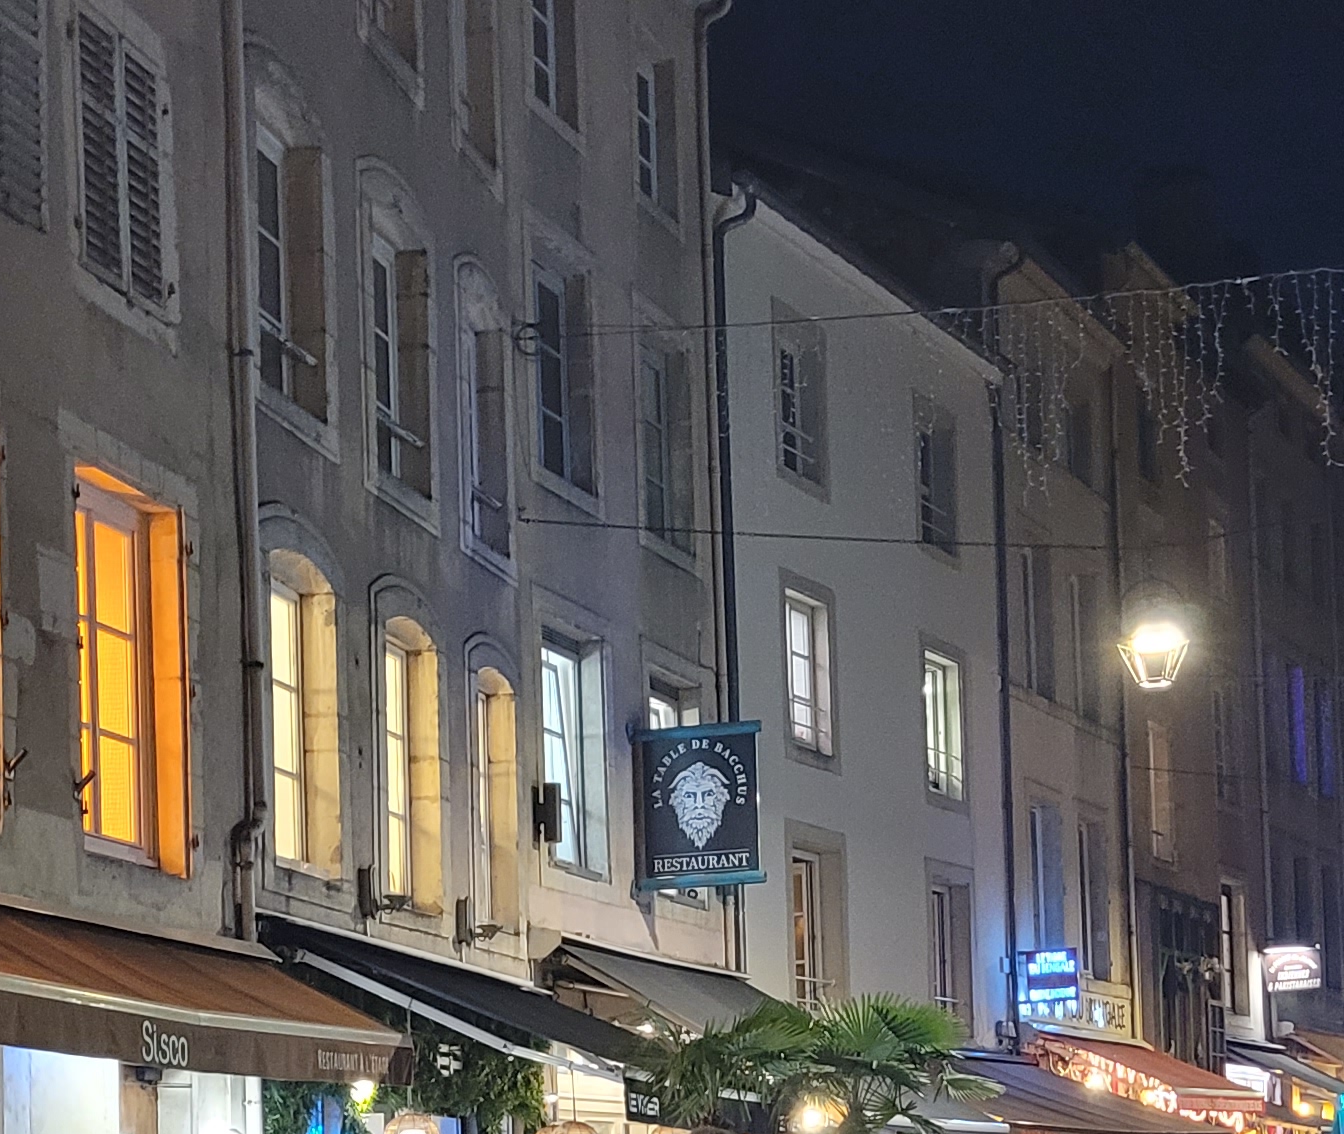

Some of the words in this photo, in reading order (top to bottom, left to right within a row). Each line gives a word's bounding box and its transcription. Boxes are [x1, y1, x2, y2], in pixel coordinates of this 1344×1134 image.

[691, 738, 710, 750] DE
[653, 743, 687, 783] TABLE
[713, 742, 749, 806] BACCHUS
[651, 789, 663, 809] LA
[653, 852, 750, 873] RESTAURANT
[141, 1019, 189, 1068] Sisco
[317, 1049, 358, 1071] RESTAURANT
